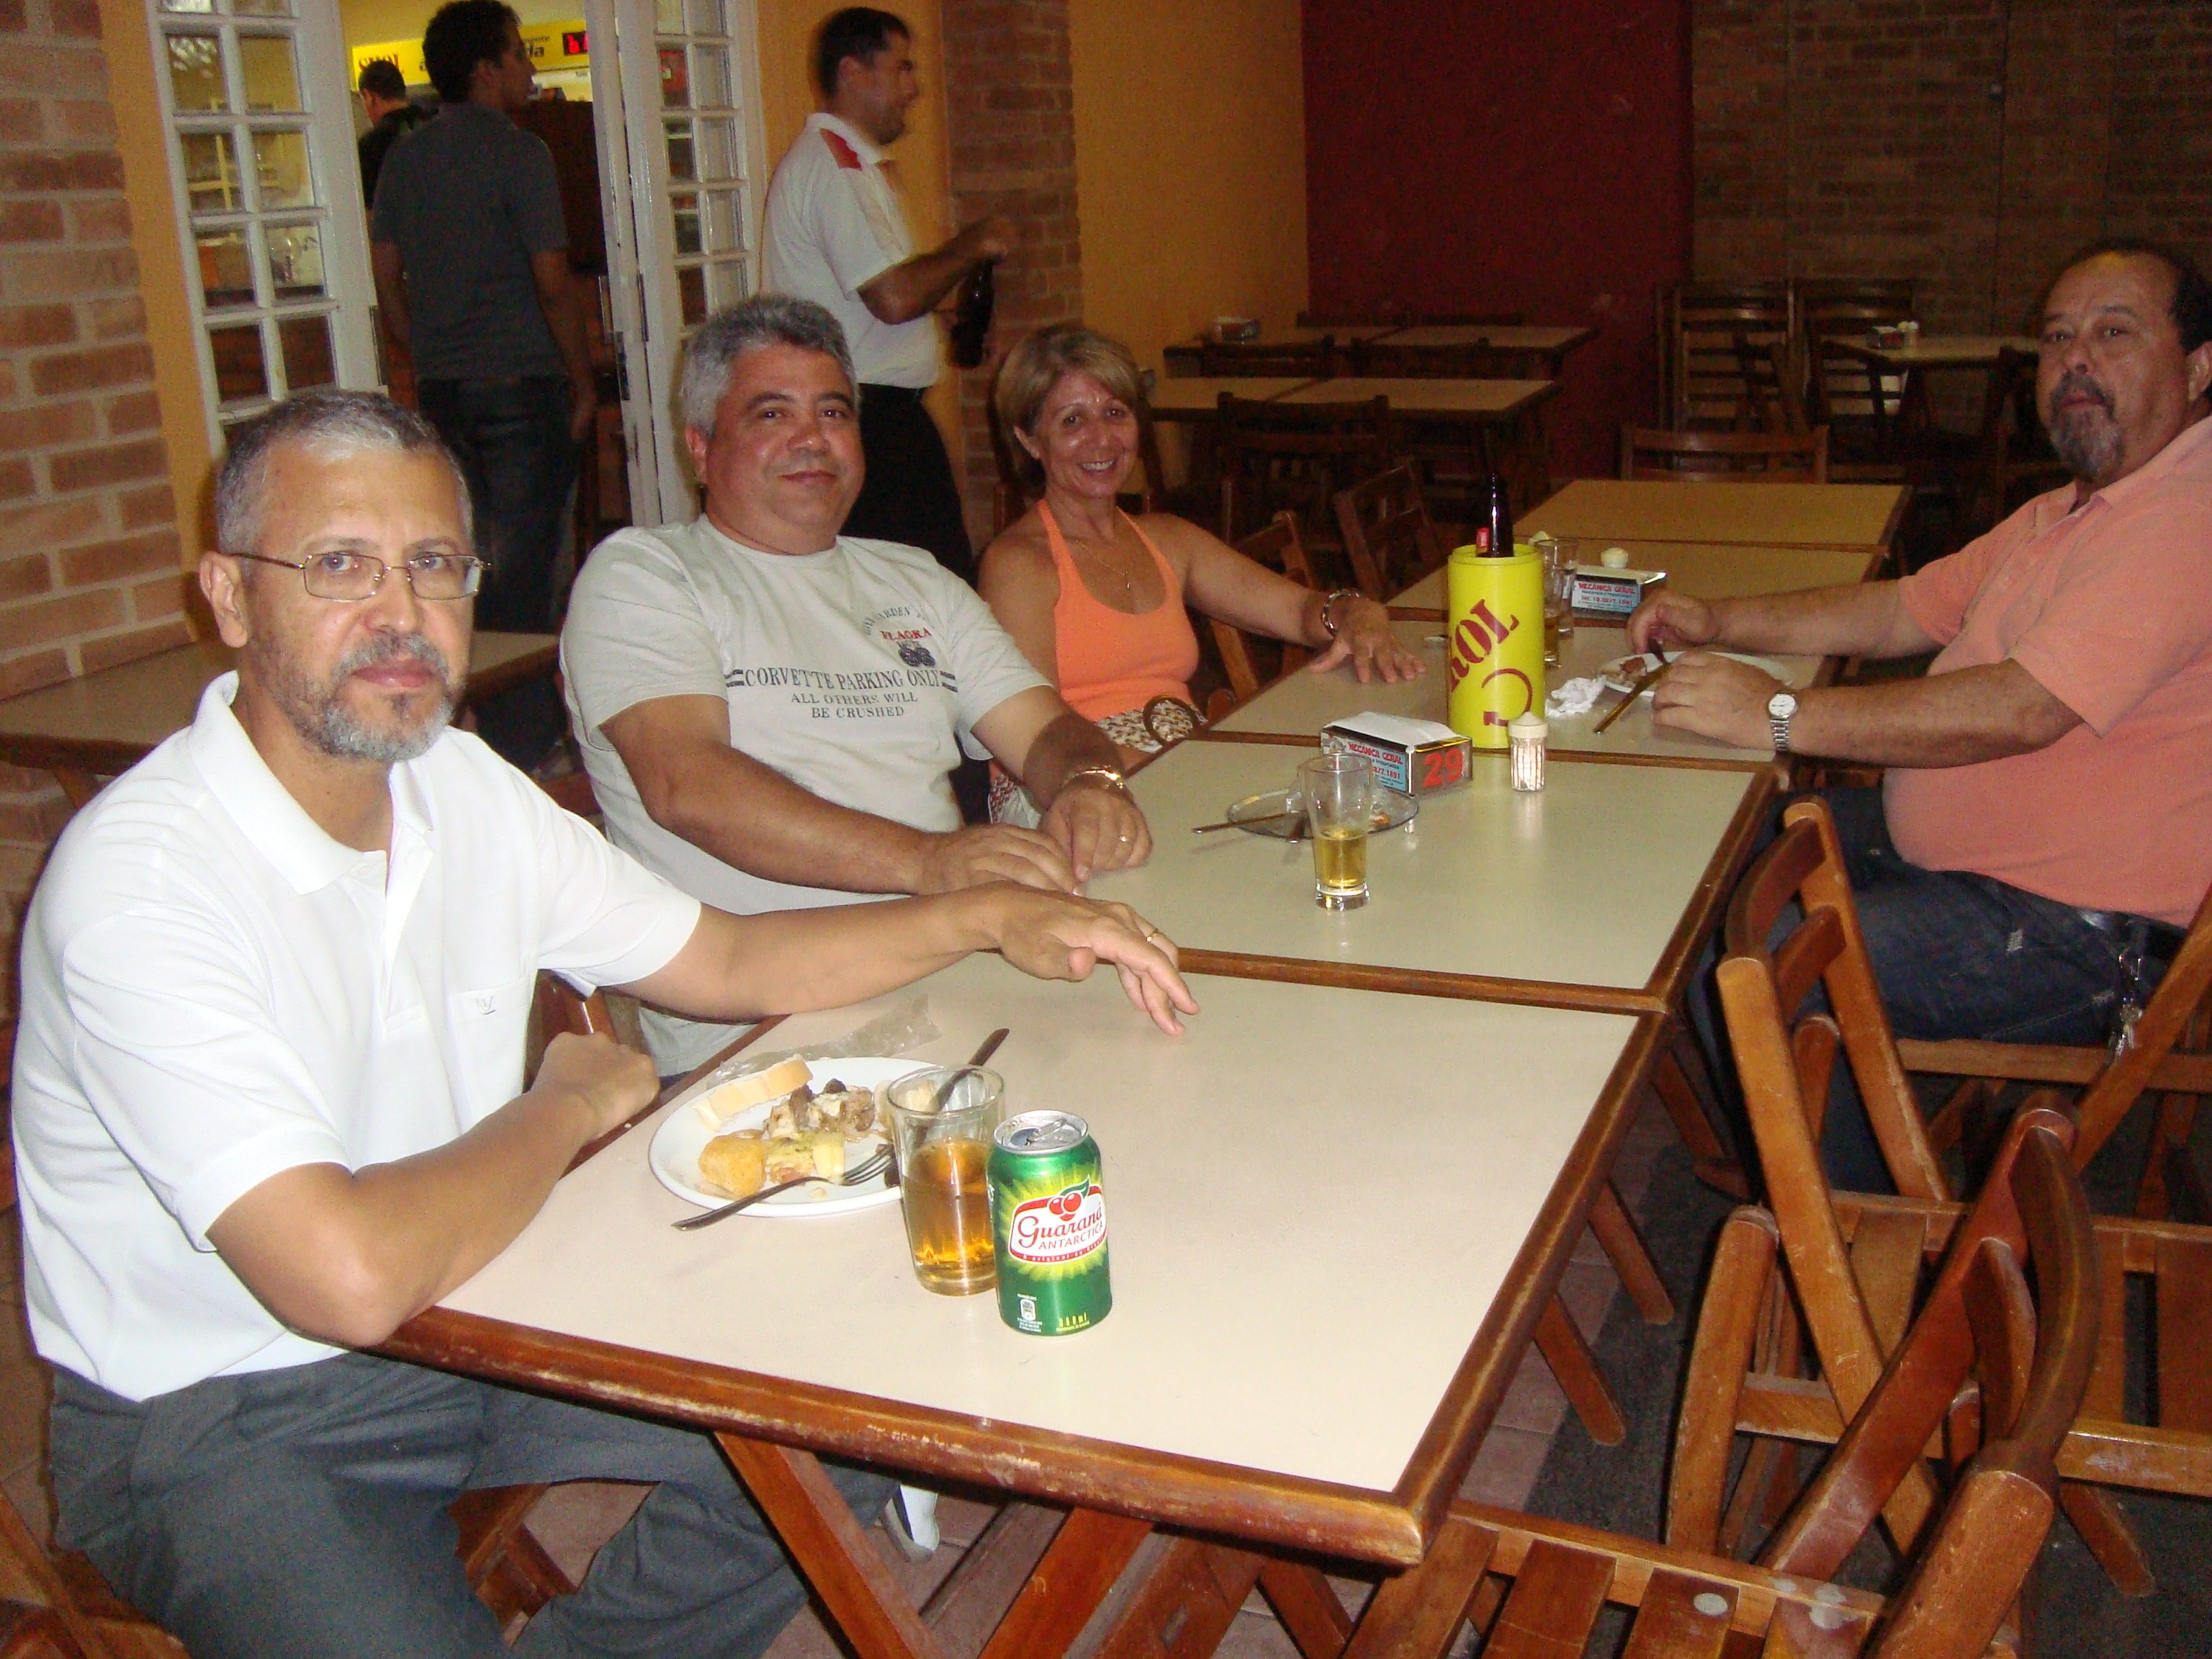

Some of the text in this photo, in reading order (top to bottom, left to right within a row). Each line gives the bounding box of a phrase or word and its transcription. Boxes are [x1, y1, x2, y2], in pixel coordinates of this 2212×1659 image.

[745, 667, 941, 691] CORVETTE PARKING ONLY
[791, 691, 918, 706] ALL OTHERS WILL
[811, 706, 905, 719] BE CRUSHED
[1423, 748, 1463, 788] 29
[1017, 1200, 1102, 1249] Guaraná
[1038, 1223, 1104, 1250] ANTARCTICA
